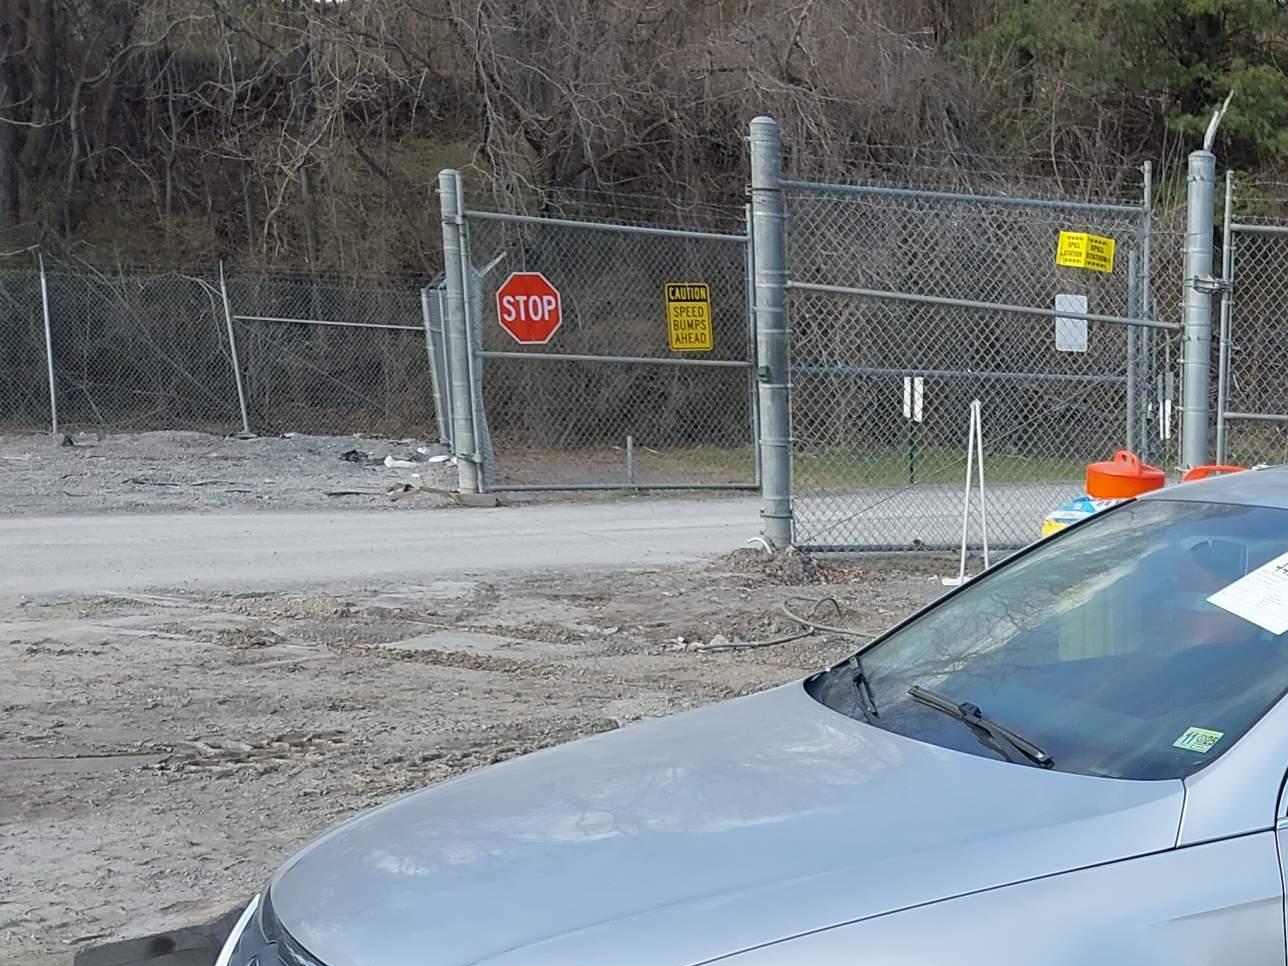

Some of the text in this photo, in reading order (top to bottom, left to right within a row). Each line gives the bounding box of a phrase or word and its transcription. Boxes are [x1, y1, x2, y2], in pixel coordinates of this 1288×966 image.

[669, 287, 706, 300] CAUTION
[503, 295, 556, 321] STOP
[673, 306, 704, 318] SPEED
[673, 319, 706, 331] BUMPS
[674, 332, 707, 344] AHEAD
